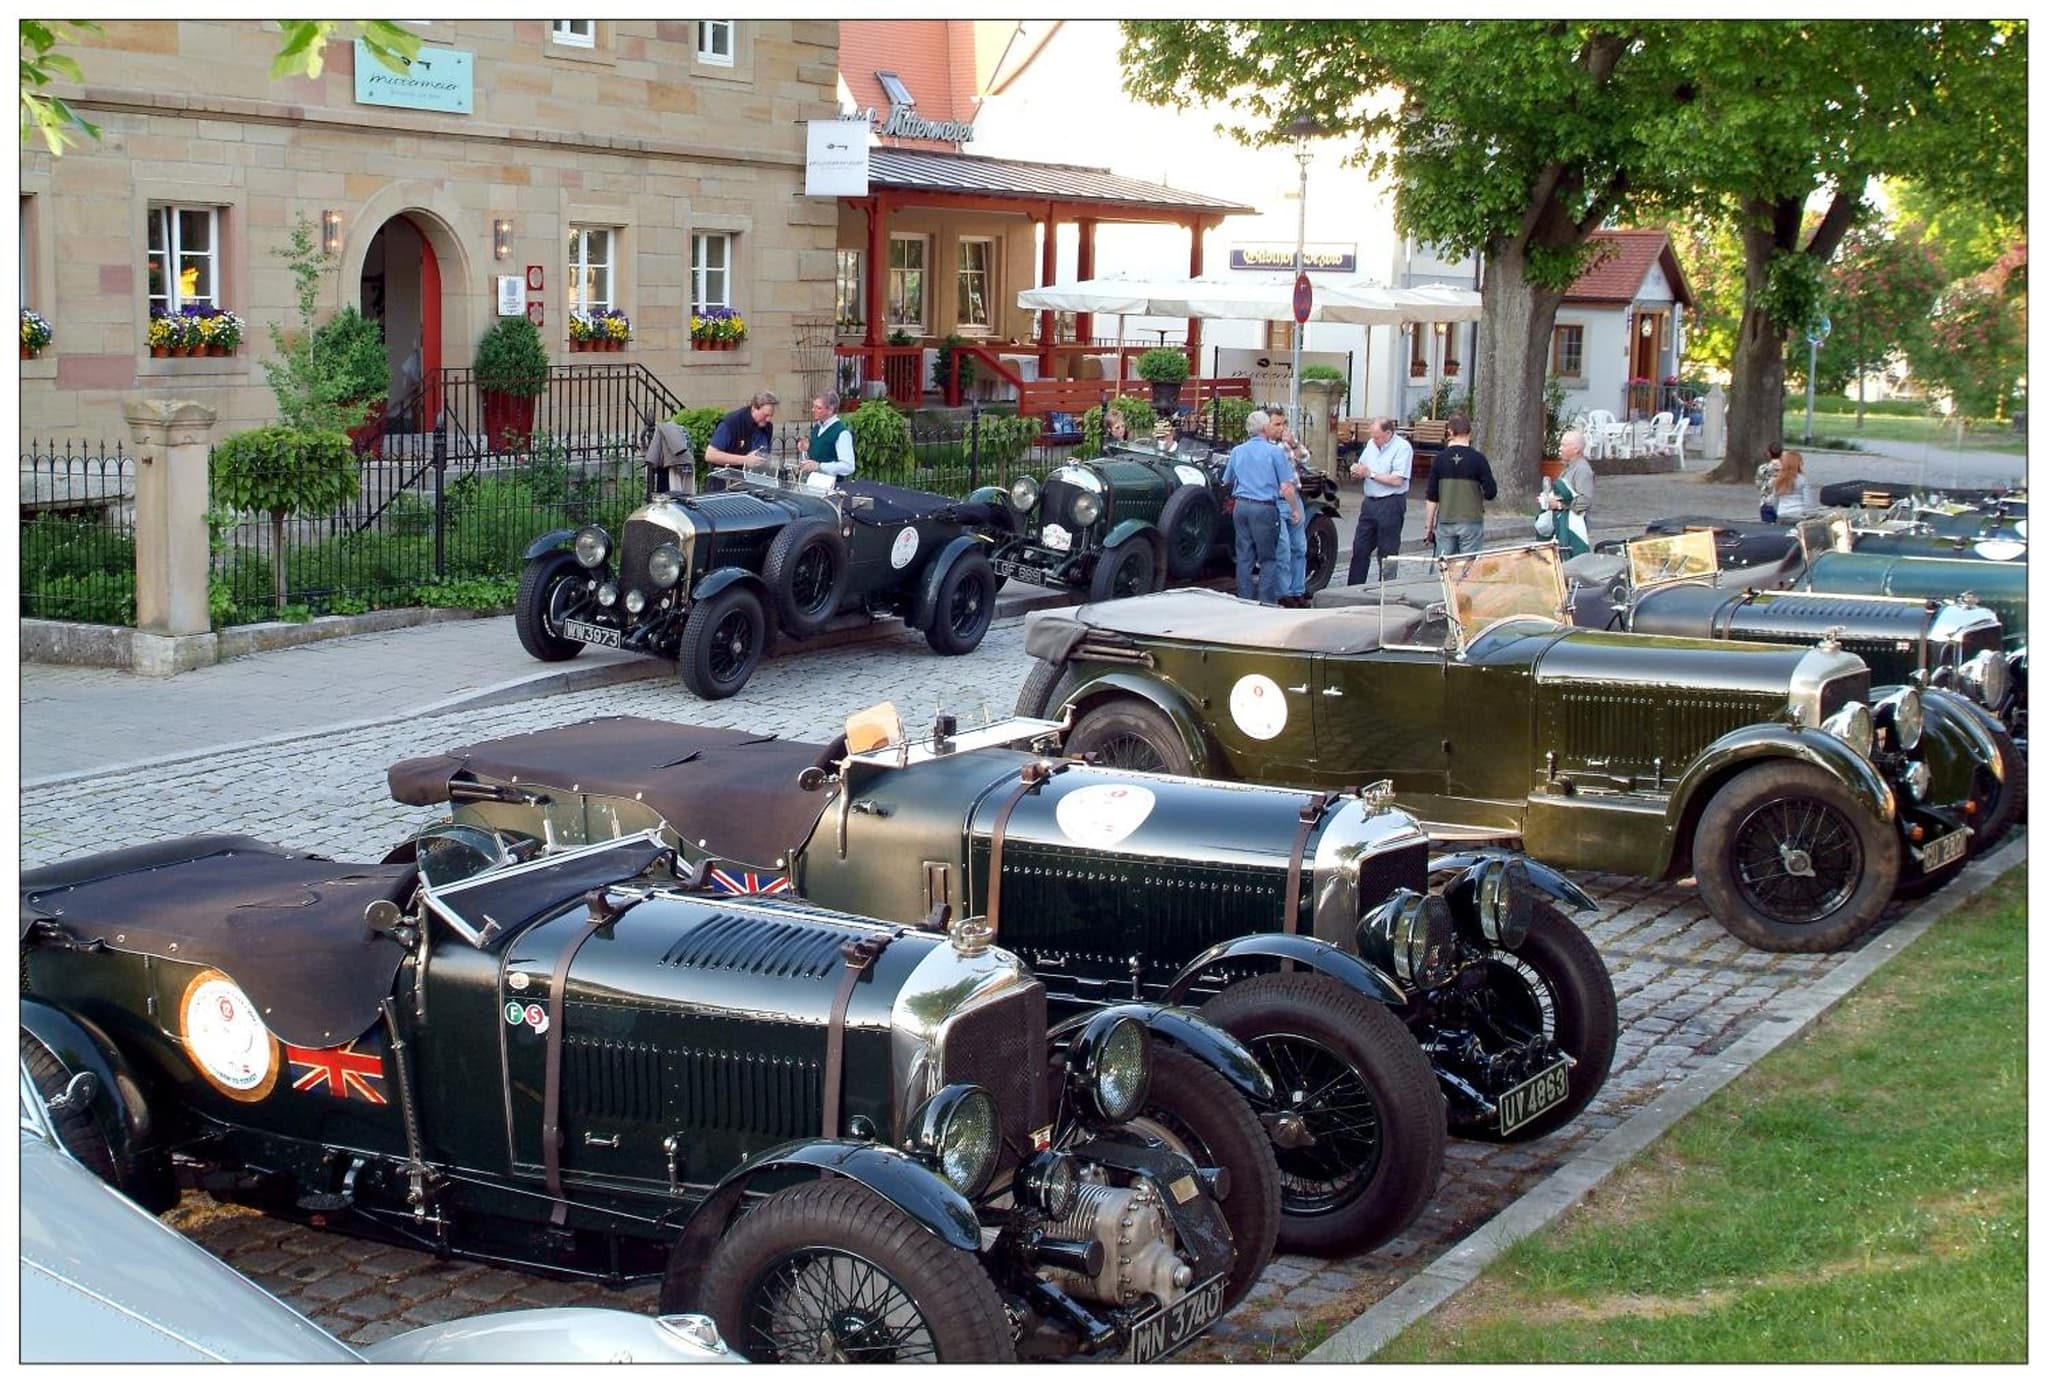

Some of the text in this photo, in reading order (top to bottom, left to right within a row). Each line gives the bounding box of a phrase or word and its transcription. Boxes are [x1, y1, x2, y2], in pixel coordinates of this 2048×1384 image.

[509, 1005, 519, 1021] F
[529, 1007, 541, 1024] S
[1527, 1067, 1566, 1113] 4863
[1136, 1315, 1166, 1363] MN
